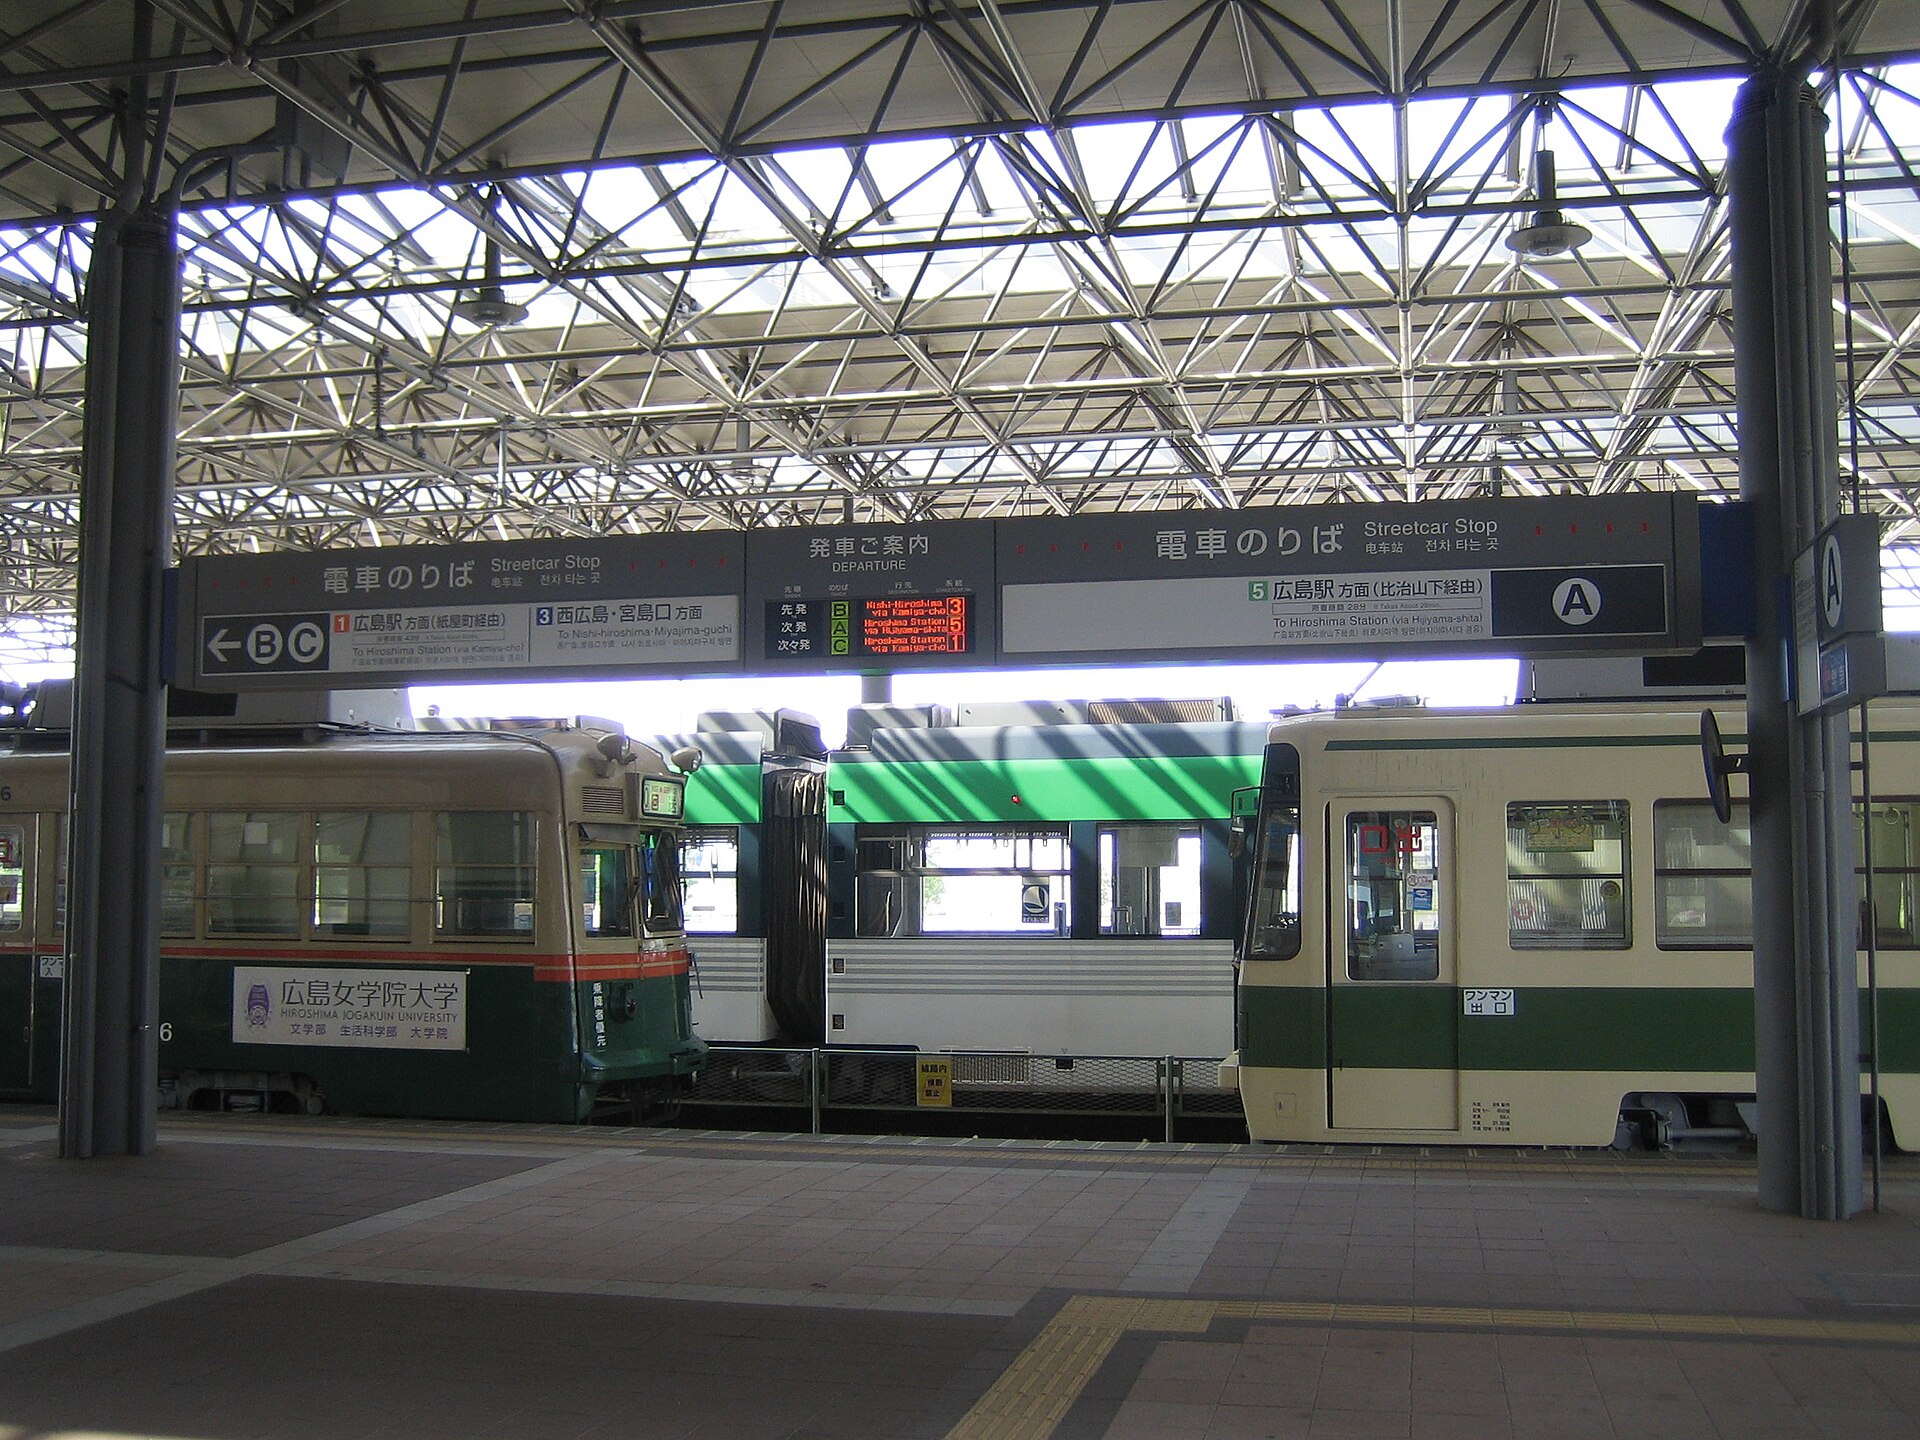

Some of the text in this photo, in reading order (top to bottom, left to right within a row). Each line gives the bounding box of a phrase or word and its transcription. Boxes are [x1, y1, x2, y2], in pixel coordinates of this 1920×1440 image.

[1364, 518, 1498, 537] Streetcar Stop
[809, 533, 929, 558] 発車ご案内
[1155, 523, 1345, 560] 電車のりば
[1425, 539, 1451, 552] 전차
[1455, 538, 1482, 551] 타는
[1486, 537, 1499, 551] 곳
[491, 554, 600, 573] Streetcar Stop
[832, 559, 906, 573] DEPARTURE
[323, 560, 475, 594] 電車のりば
[1826, 546, 1840, 612] A
[828, 583, 849, 592] のりば
[1252, 583, 1265, 599] 5
[866, 598, 962, 615] Nishi-Hiroshima 3
[1561, 583, 1593, 616] A
[539, 609, 550, 623] 3
[780, 603, 808, 616] 先発
[833, 603, 847, 617] B
[871, 607, 946, 617] via Kamiya-cho
[337, 617, 347, 632] 1
[781, 620, 808, 633] 次発
[832, 620, 847, 635] A
[864, 617, 962, 632] Hiroshima Station 5
[1274, 613, 1483, 628] To Hiroshima Station (via Hijiyama-shita)
[558, 630, 570, 640] To
[864, 626, 880, 635] via
[255, 627, 318, 659] B C
[777, 639, 811, 652] 次々発
[833, 638, 846, 652] C
[864, 636, 907, 646] Hiroshima
[911, 635, 945, 644] Station
[871, 643, 946, 653] via Kamiya-cho
[352, 647, 364, 656] To
[366, 646, 414, 656] Hiroshima
[418, 645, 451, 655] Station
[281, 979, 459, 1010] 広島女学院大学
[1465, 990, 1512, 1001] ワンマン
[1471, 1002, 1507, 1014] 出口
[281, 1009, 458, 1023] HIROSHIMA JOGAKUIN UNIVERSITY
[159, 1022, 173, 1042] 6
[290, 1023, 448, 1040] 文学部 生活科学部 大学院
